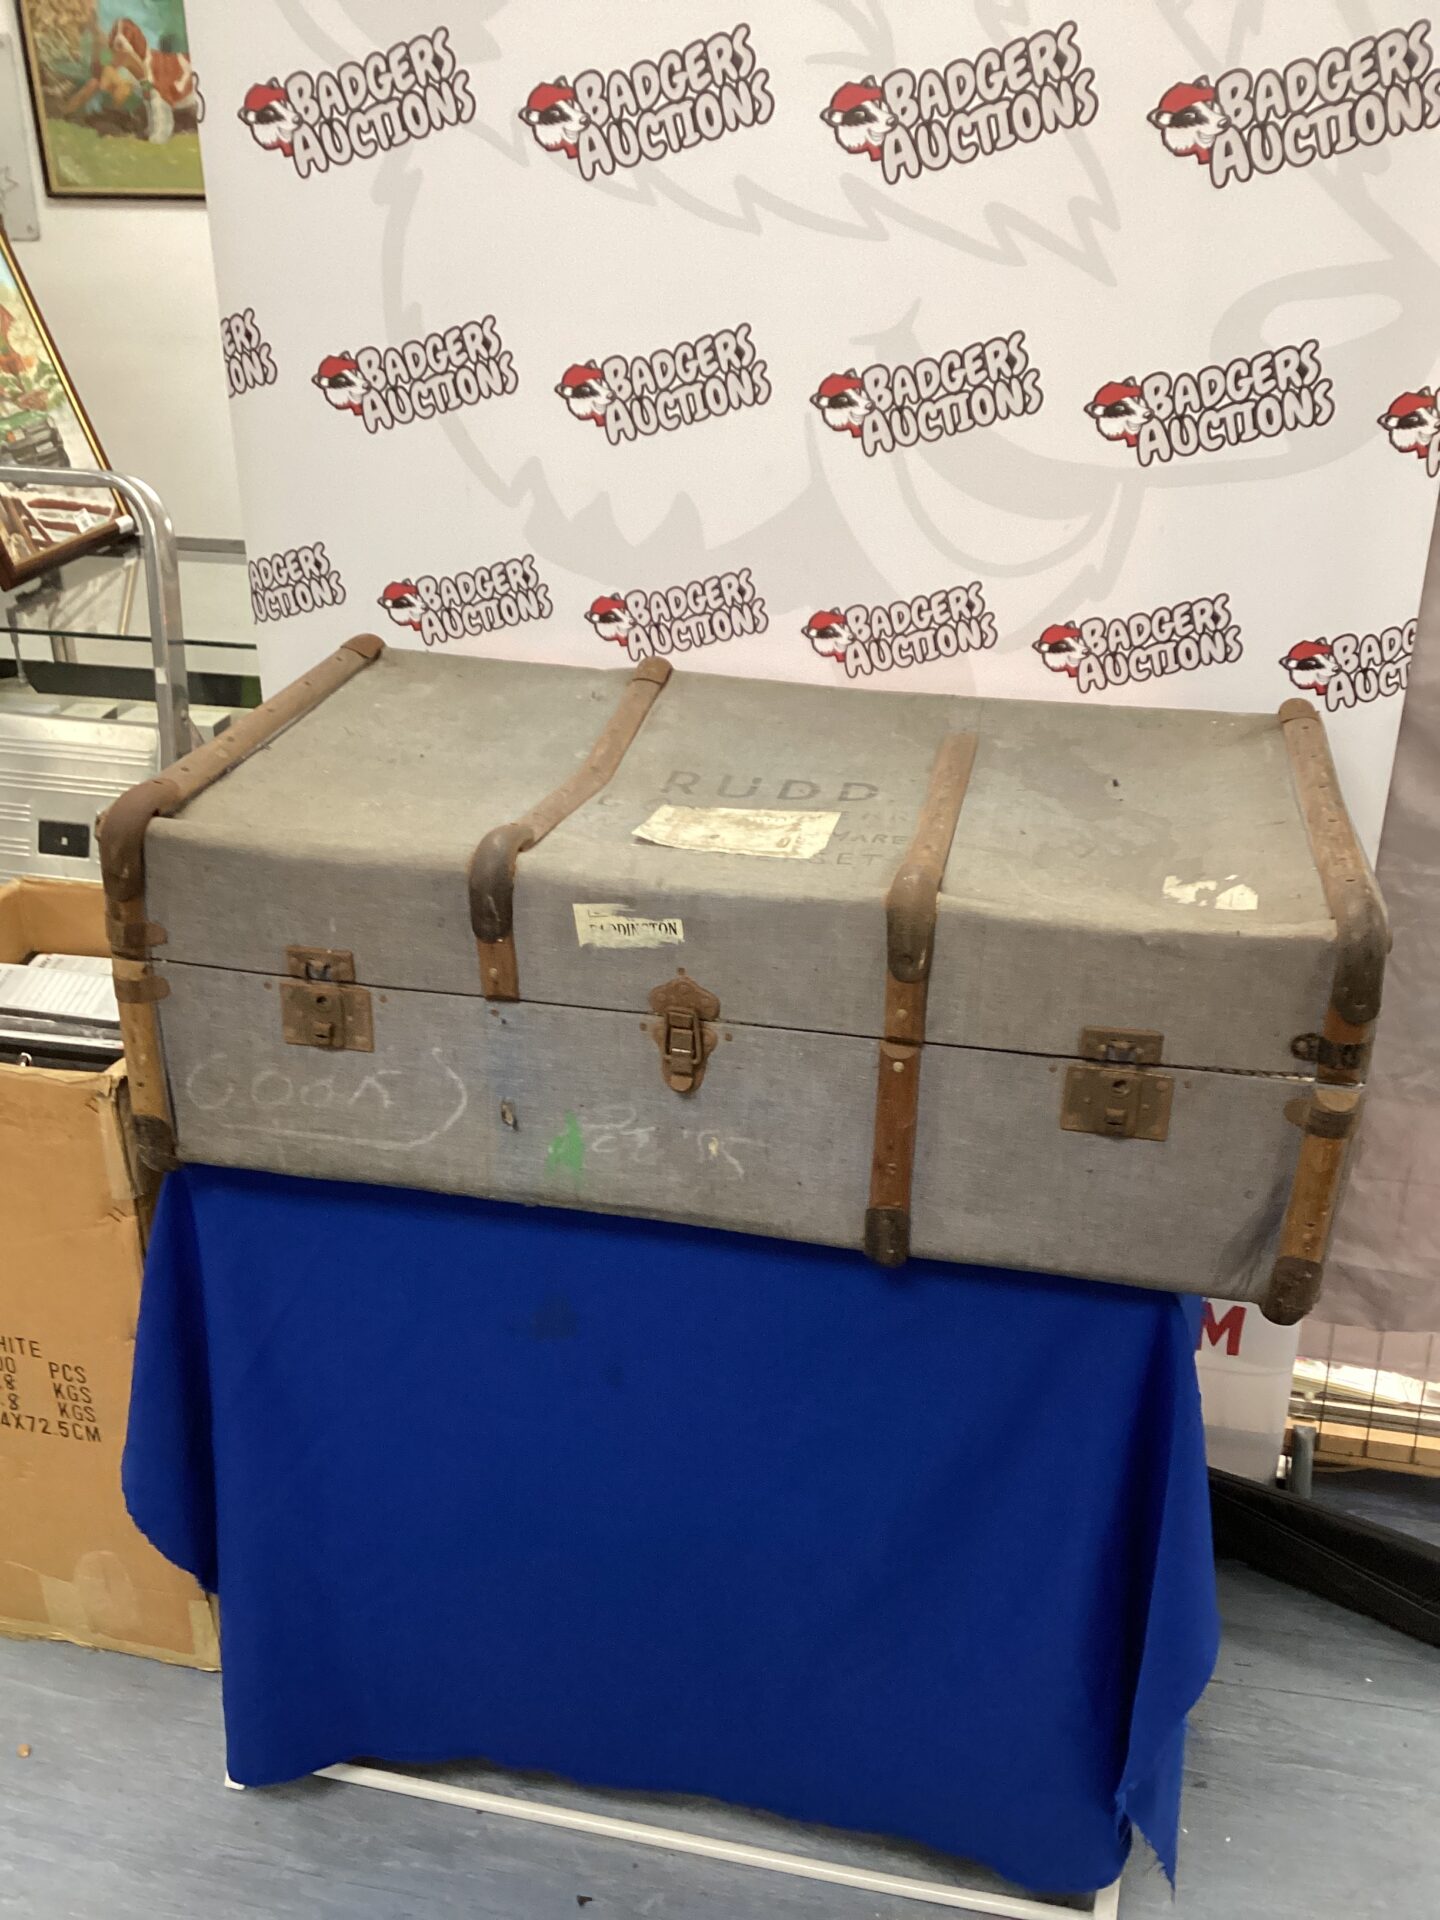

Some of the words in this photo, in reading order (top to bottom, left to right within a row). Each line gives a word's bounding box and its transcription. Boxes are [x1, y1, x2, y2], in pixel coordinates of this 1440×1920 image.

[284, 26, 456, 125] BADGERS
[572, 23, 756, 127] BADGERS
[881, 21, 1081, 128] BADGERS
[1215, 19, 1433, 133] BADGERS
[291, 70, 475, 179] AUCTIONS
[576, 68, 774, 181] AUCTIONS
[881, 68, 1098, 185] AUCTIONS
[356, 315, 501, 393] BADGERS
[361, 351, 518, 433] AUCTIONS
[603, 323, 756, 400] BADGERS
[862, 330, 1028, 412] BADGERS
[1141, 339, 1321, 420] BADGERS
[604, 360, 772, 445] AUCTIONS
[860, 369, 1044, 457] AUCTIONS
[1137, 379, 1335, 467] AUCTIONS
[251, 570, 346, 624] UCTIONS
[416, 554, 538, 610] BADGERS
[421, 584, 553, 646] AUCTIONS
[627, 568, 755, 626] BADGERS
[845, 581, 985, 643] BADGERS
[627, 597, 769, 661] AUCTIONS
[844, 612, 998, 678] AUCTIONS
[1077, 625, 1243, 693] AUCTIONS
[1081, 593, 1231, 657] BADGERS
[48, 1361, 87, 1384] PCS
[53, 1382, 92, 1404] KGS
[57, 1401, 97, 1423] KGS
